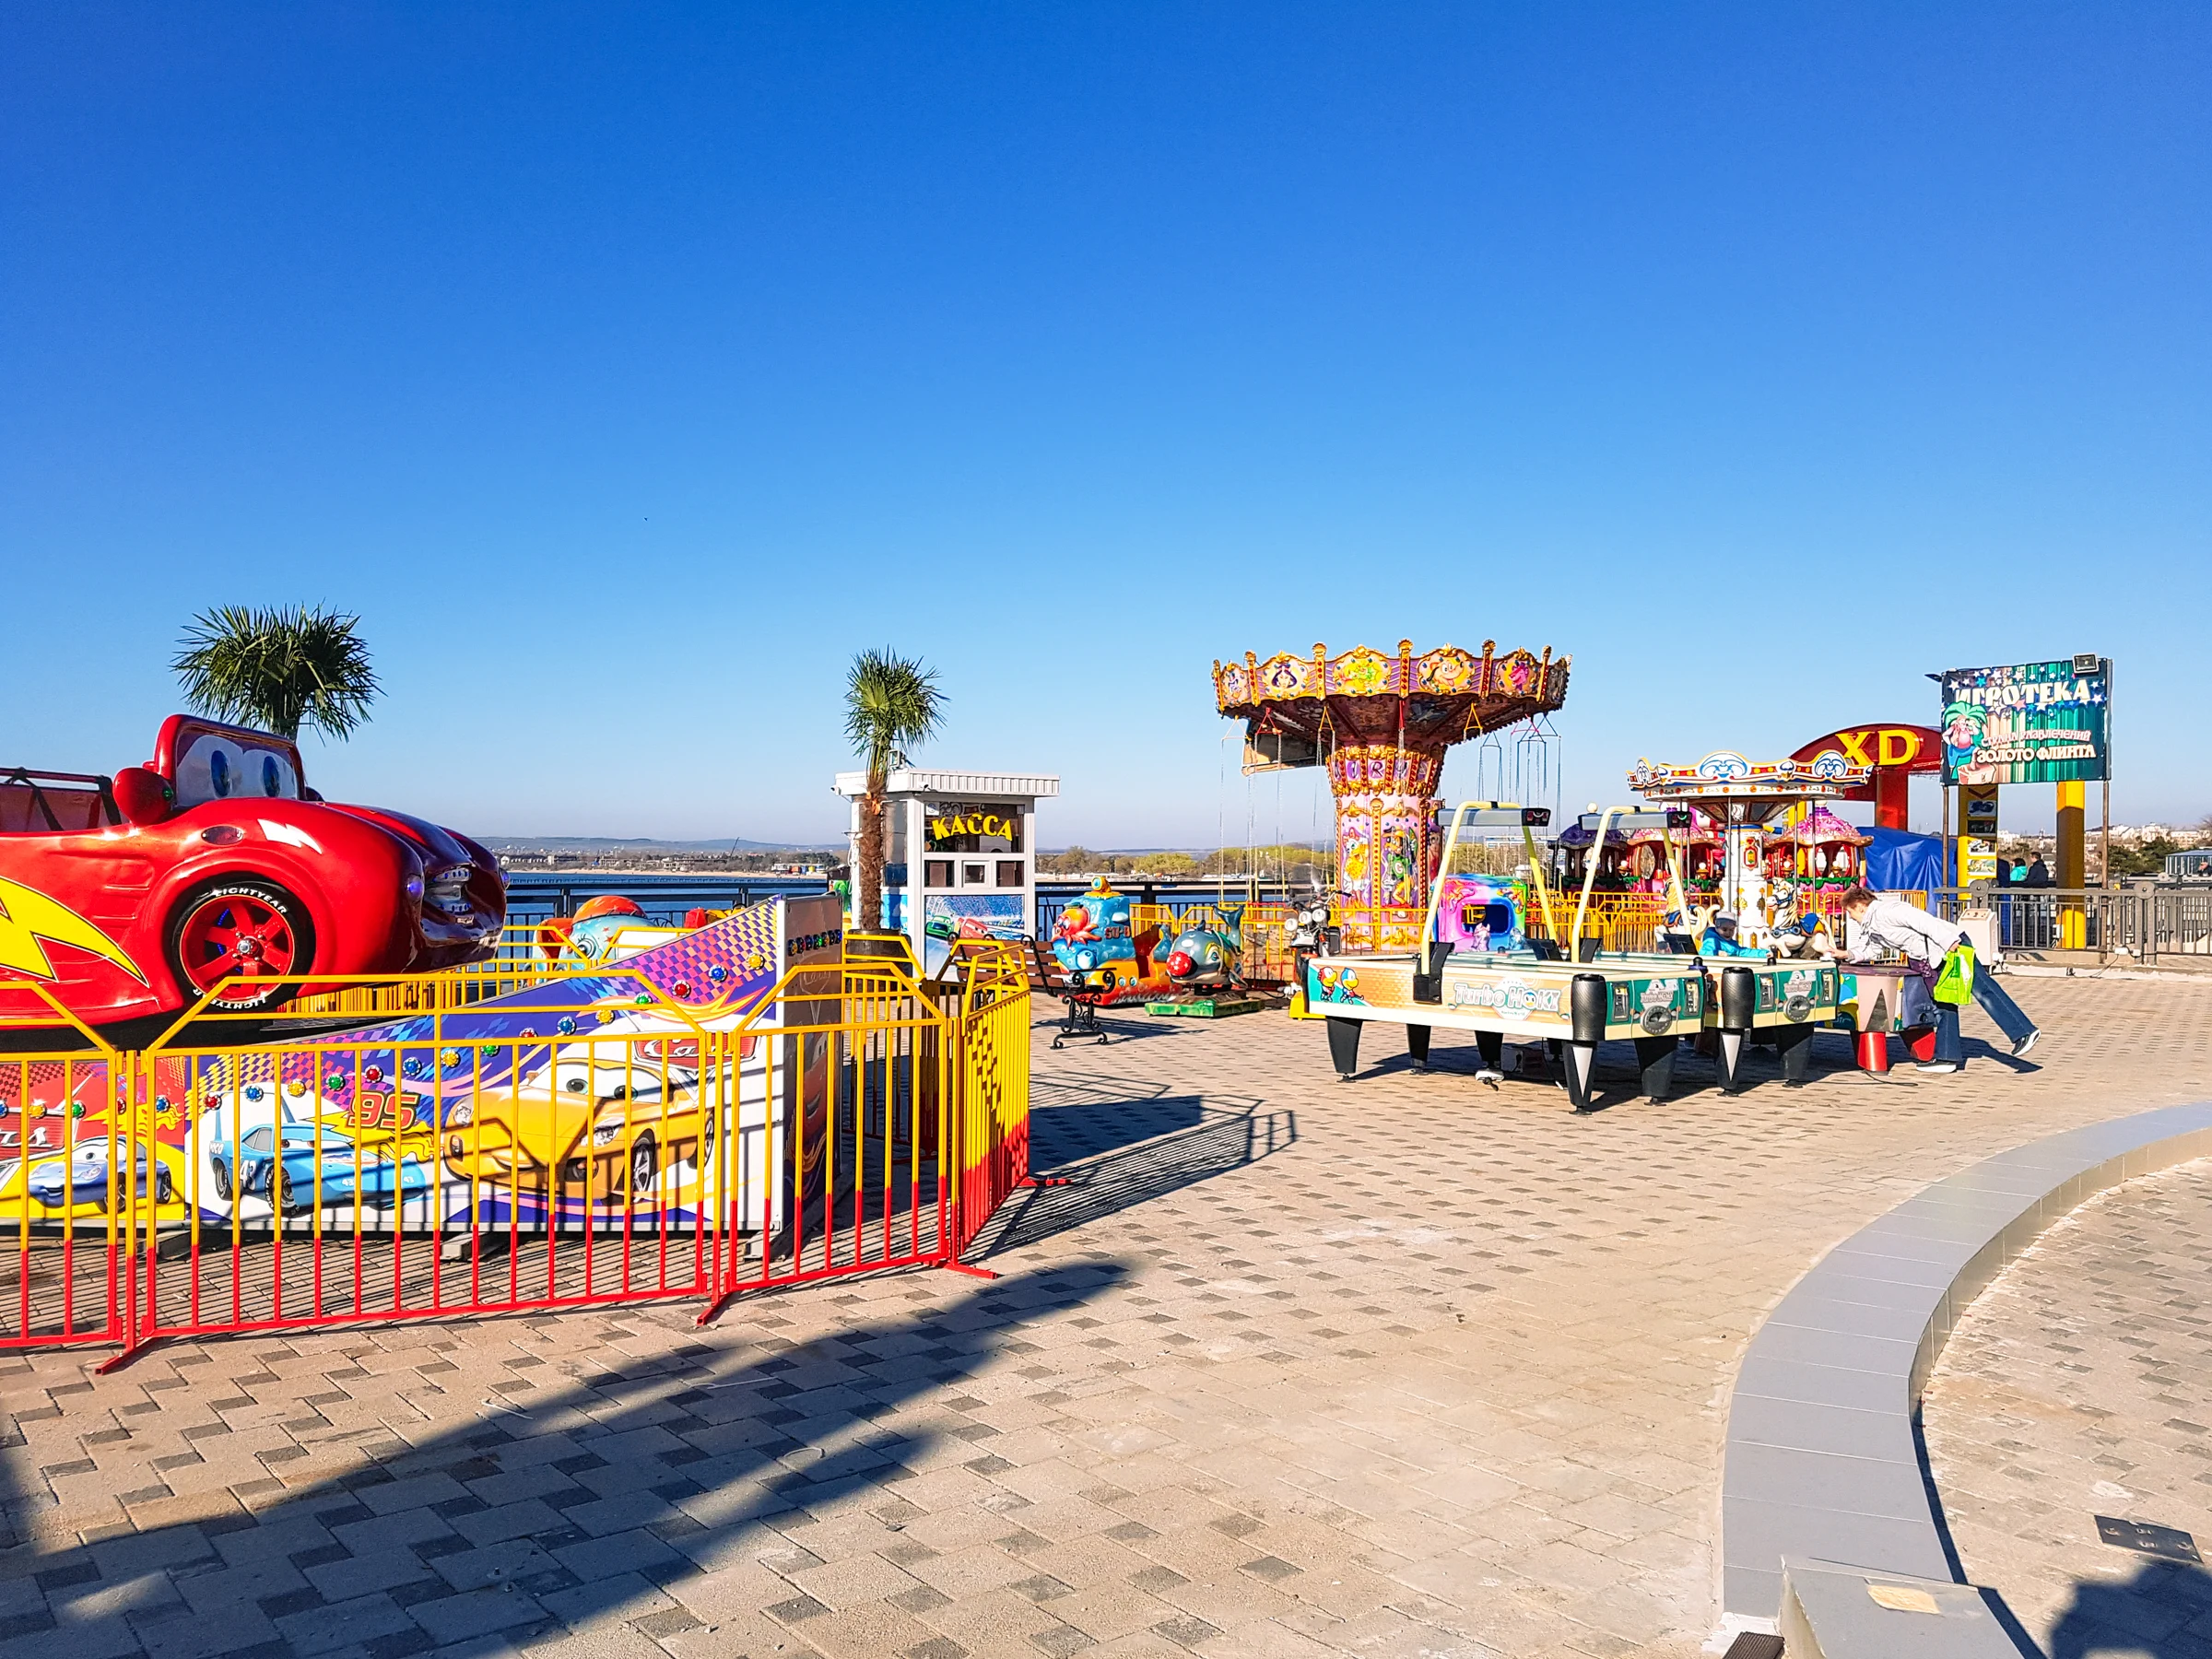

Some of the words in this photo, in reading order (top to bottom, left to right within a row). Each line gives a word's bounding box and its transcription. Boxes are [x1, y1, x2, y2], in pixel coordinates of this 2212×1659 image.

[1955, 679, 2090, 708] ИГРОТЕКА
[1835, 729, 1920, 767] XD
[1981, 732, 2018, 747] СТРАНА
[2019, 729, 2091, 742] РАЗВЛЕЧЕНИЙ
[1976, 747, 2035, 763] ЗОЛОТО
[2036, 744, 2097, 760] ФЛИНТА
[932, 813, 1013, 841] КАССА
[192, 987, 266, 1010] LIGHTYER
[1455, 984, 1506, 1006] Turbo
[347, 1091, 419, 1130] 95
